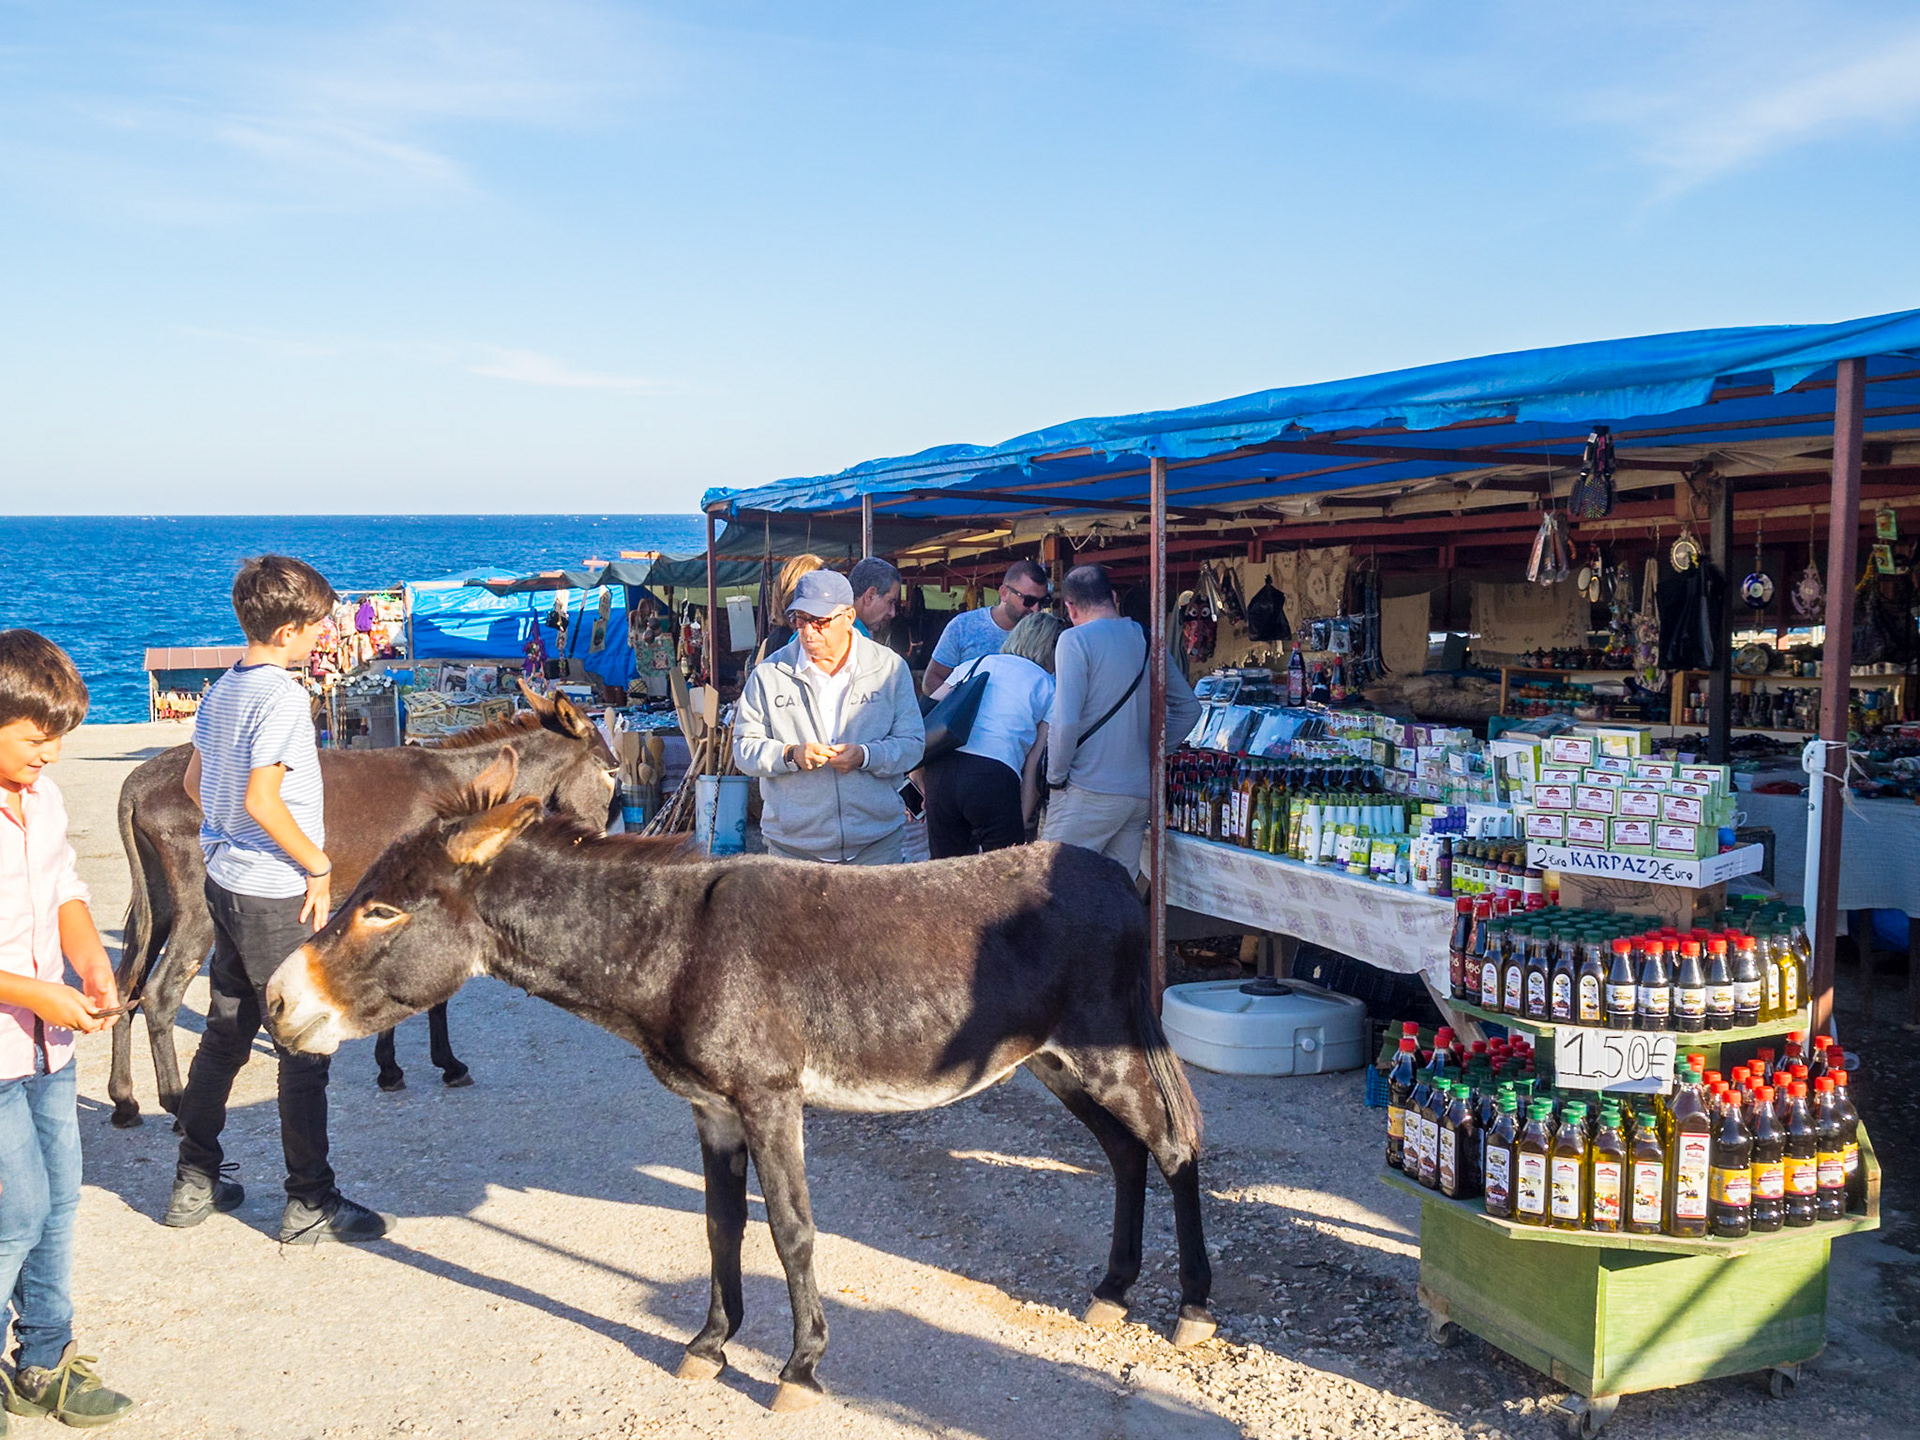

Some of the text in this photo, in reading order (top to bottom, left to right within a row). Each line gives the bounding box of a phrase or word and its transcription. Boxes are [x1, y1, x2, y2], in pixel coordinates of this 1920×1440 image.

[1533, 847, 1549, 869] 2
[1570, 851, 1646, 874] KARPAZ
[1648, 859, 1660, 880] 2
